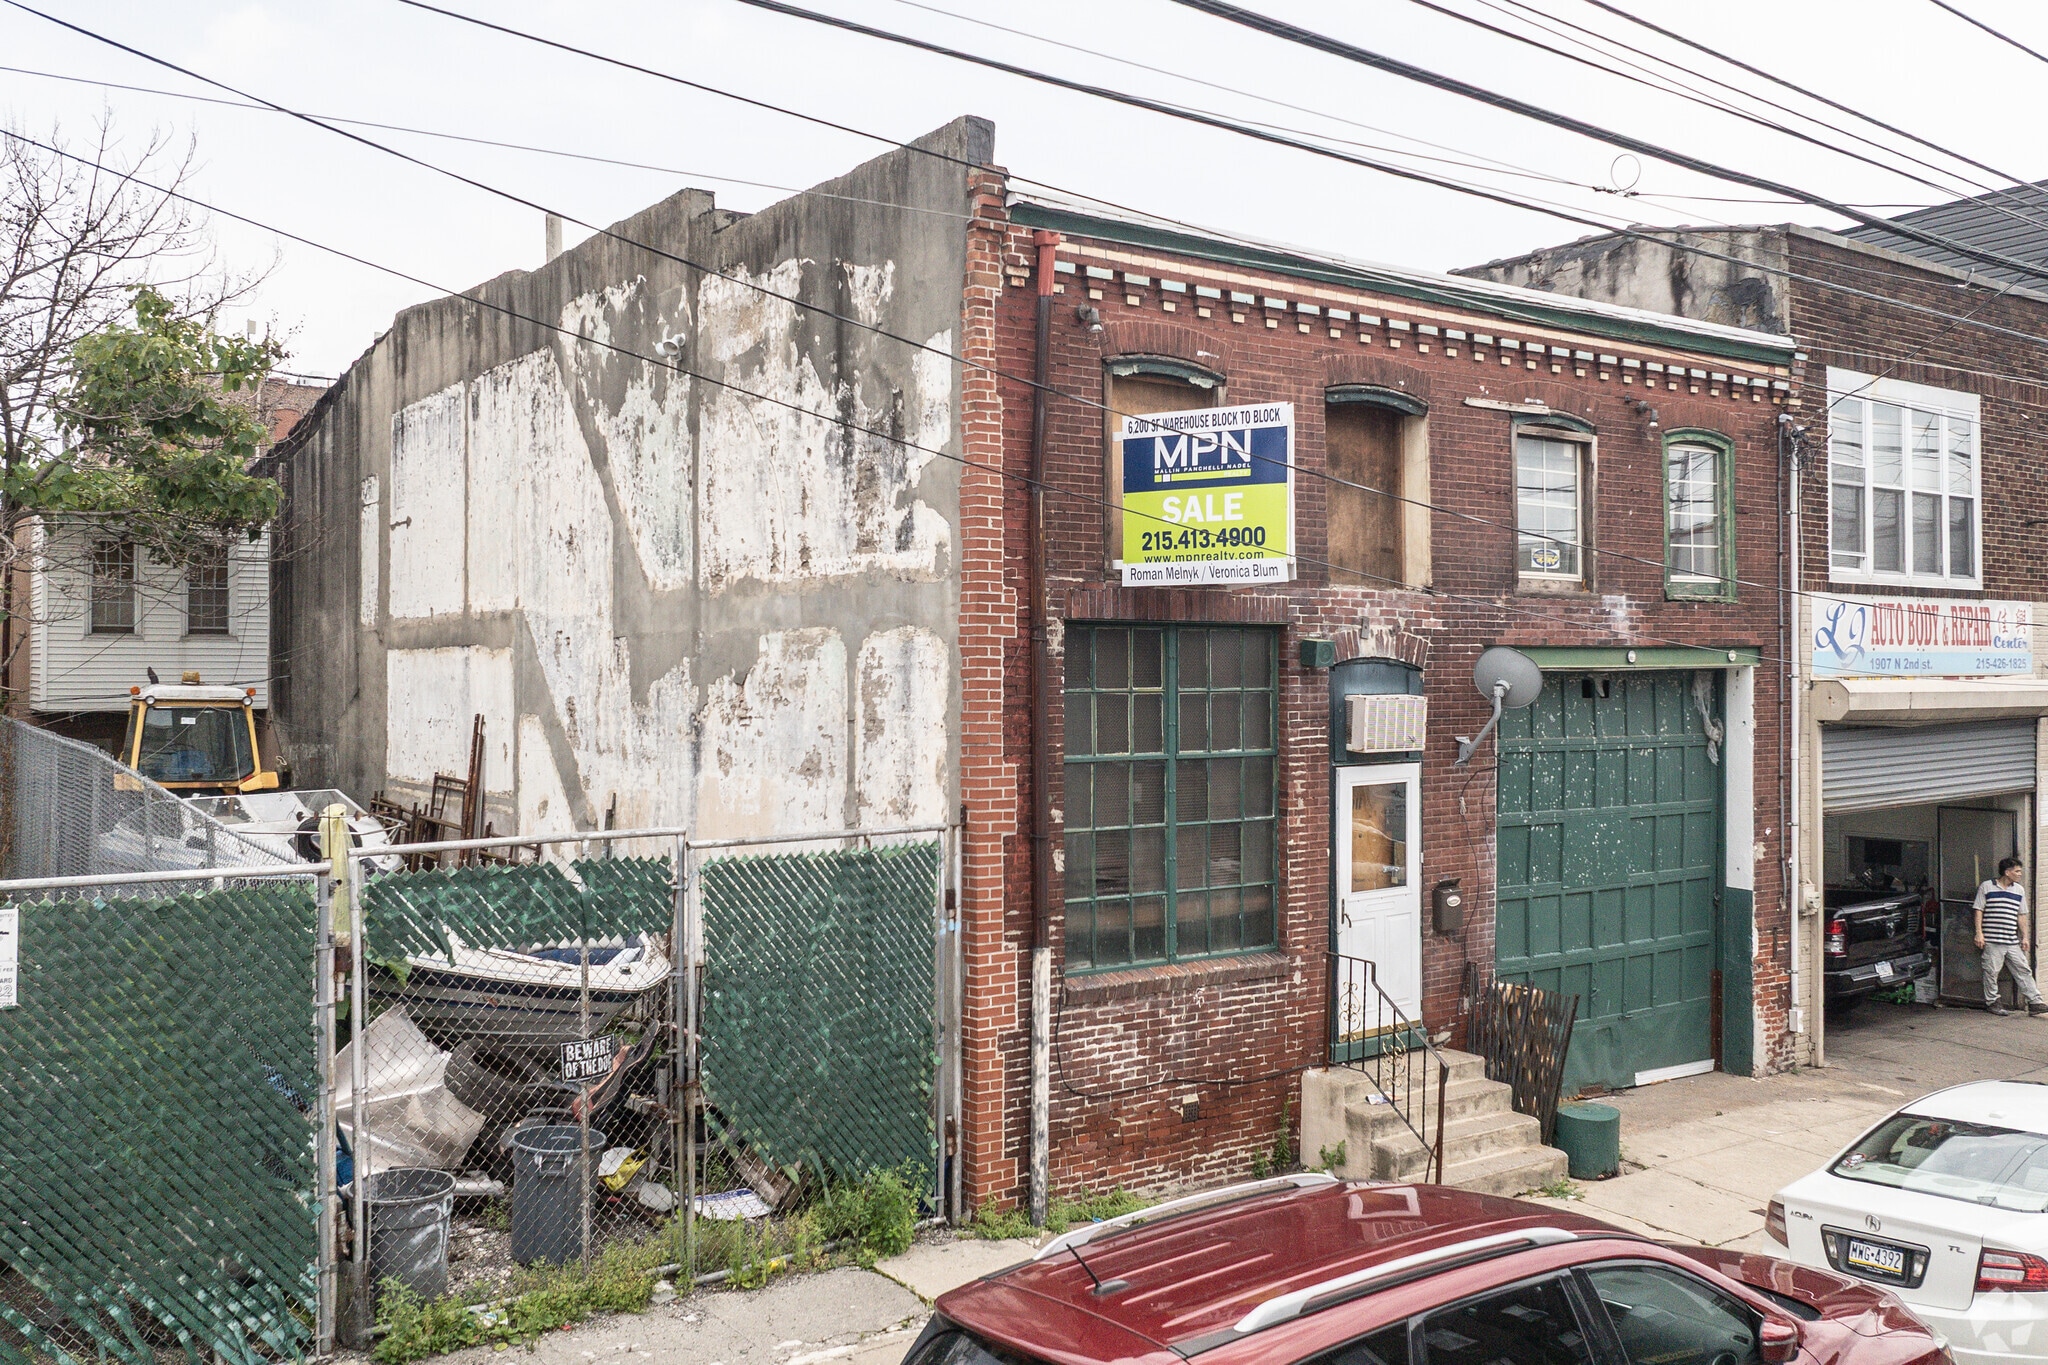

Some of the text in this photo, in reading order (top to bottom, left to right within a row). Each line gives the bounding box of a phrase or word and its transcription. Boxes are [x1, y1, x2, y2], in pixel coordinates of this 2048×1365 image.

[1128, 408, 1281, 434] 6,200 SF WAREHOUSE BLOCK TO BLOCK
[1154, 429, 1251, 469] MPN
[1162, 492, 1244, 524] SALE
[1142, 526, 1266, 551] 215.413.4900
[1130, 564, 1279, 582] Roman Melnyk / Veronica Blum
[1871, 603, 1904, 646] AUTO
[1907, 604, 1939, 646] BODY
[1942, 616, 1949, 646] &
[1951, 606, 1992, 646] REPAIR
[1993, 635, 2028, 649] Center
[1870, 658, 1892, 670] 1907
[1894, 658, 1901, 670] N
[1904, 658, 1919, 670] 2nd
[1976, 658, 2027, 670] 215-426-1825
[566, 1037, 612, 1061] BEWARE
[565, 1062, 579, 1079] OF
[580, 1058, 598, 1077] THE
